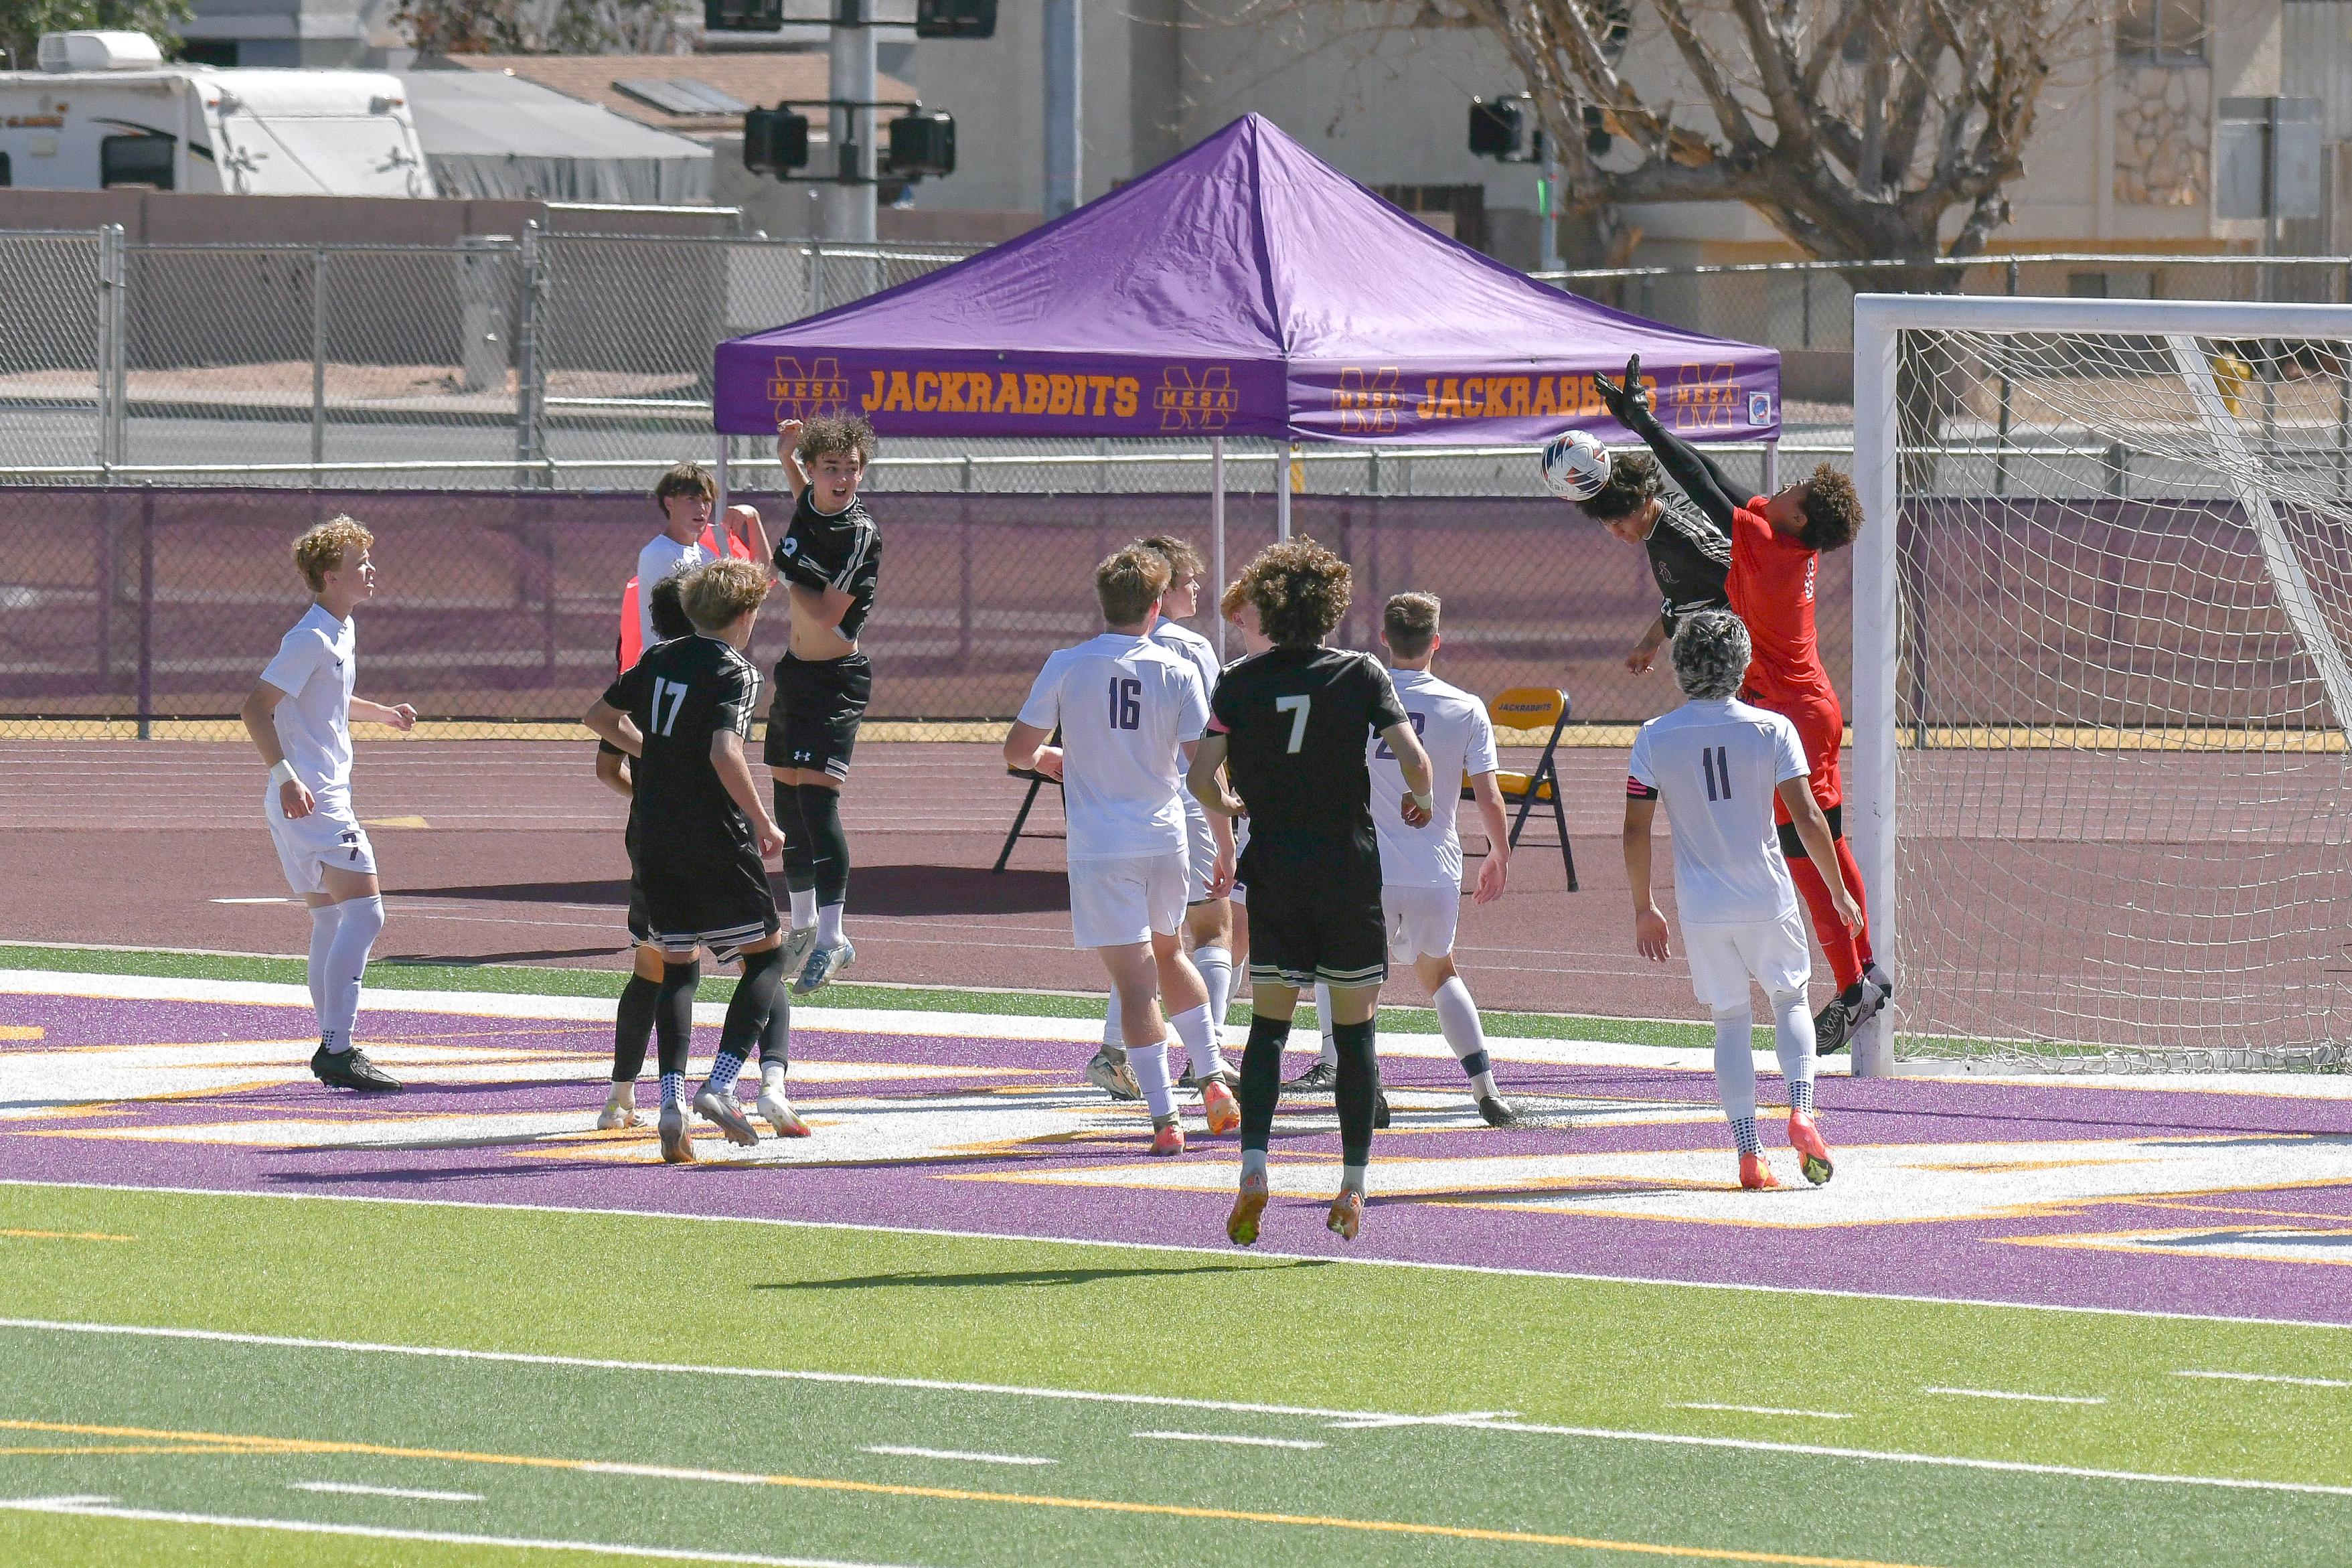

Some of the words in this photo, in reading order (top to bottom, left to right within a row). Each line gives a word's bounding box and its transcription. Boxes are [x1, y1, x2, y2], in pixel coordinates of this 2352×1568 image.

[775, 382, 841, 398] MESA
[862, 371, 1140, 417] JACKRABBITS
[1162, 390, 1229, 407] MESA
[1340, 392, 1399, 408] MESA
[1677, 387, 1733, 403] MESA
[651, 676, 688, 736] 17
[1109, 677, 1142, 730] 16
[1275, 694, 1311, 755] 7
[1703, 746, 1732, 801] 11
[341, 832, 359, 862] 7
